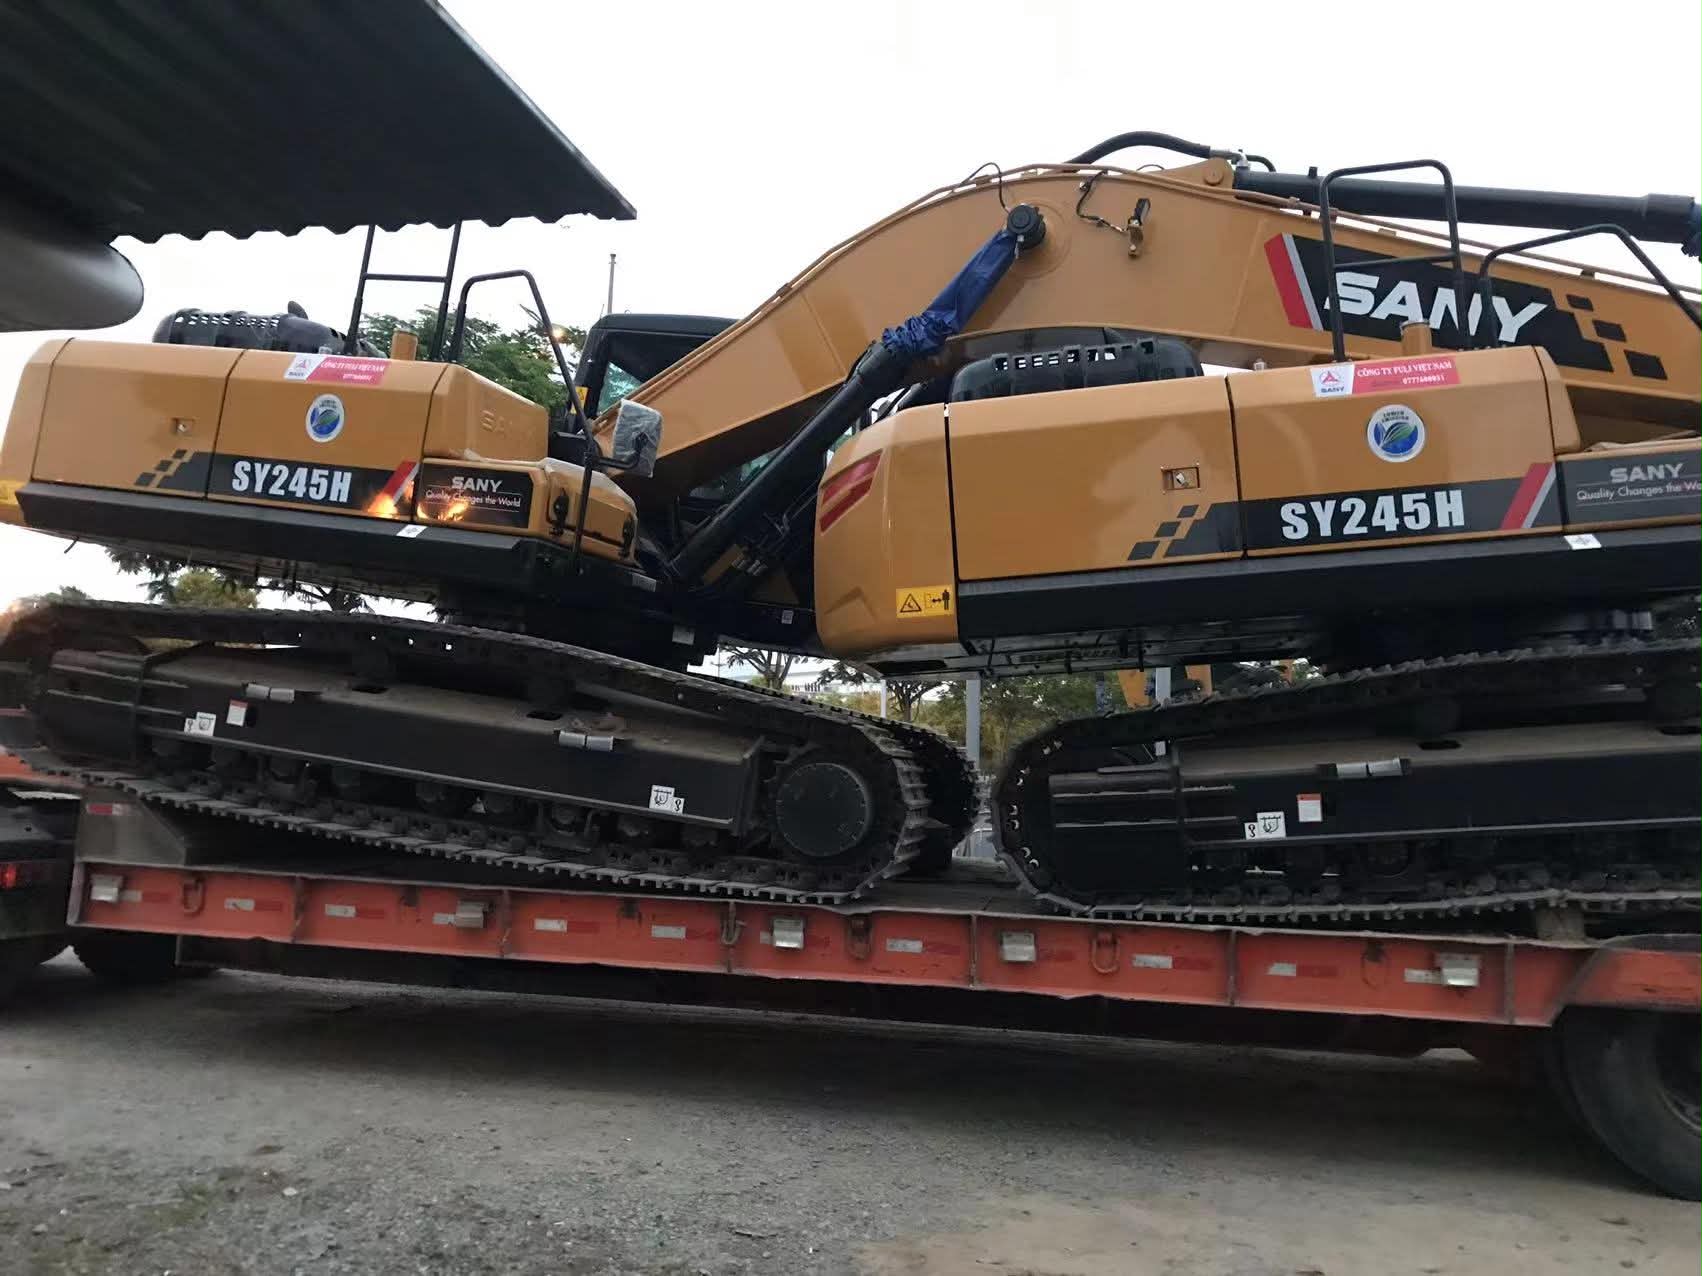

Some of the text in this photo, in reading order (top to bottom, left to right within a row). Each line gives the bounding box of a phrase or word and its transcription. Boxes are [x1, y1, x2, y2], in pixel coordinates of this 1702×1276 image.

[1324, 271, 1548, 343] SANY
[231, 460, 353, 503] SY245H
[1610, 463, 1683, 484] SANY
[451, 476, 503, 493] SANY
[1576, 488, 1615, 500] Quality
[1617, 485, 1663, 497] Changes
[1666, 482, 1682, 492] the
[485, 495, 497, 505] the
[498, 497, 521, 507] World
[1280, 489, 1465, 540] SY245H
